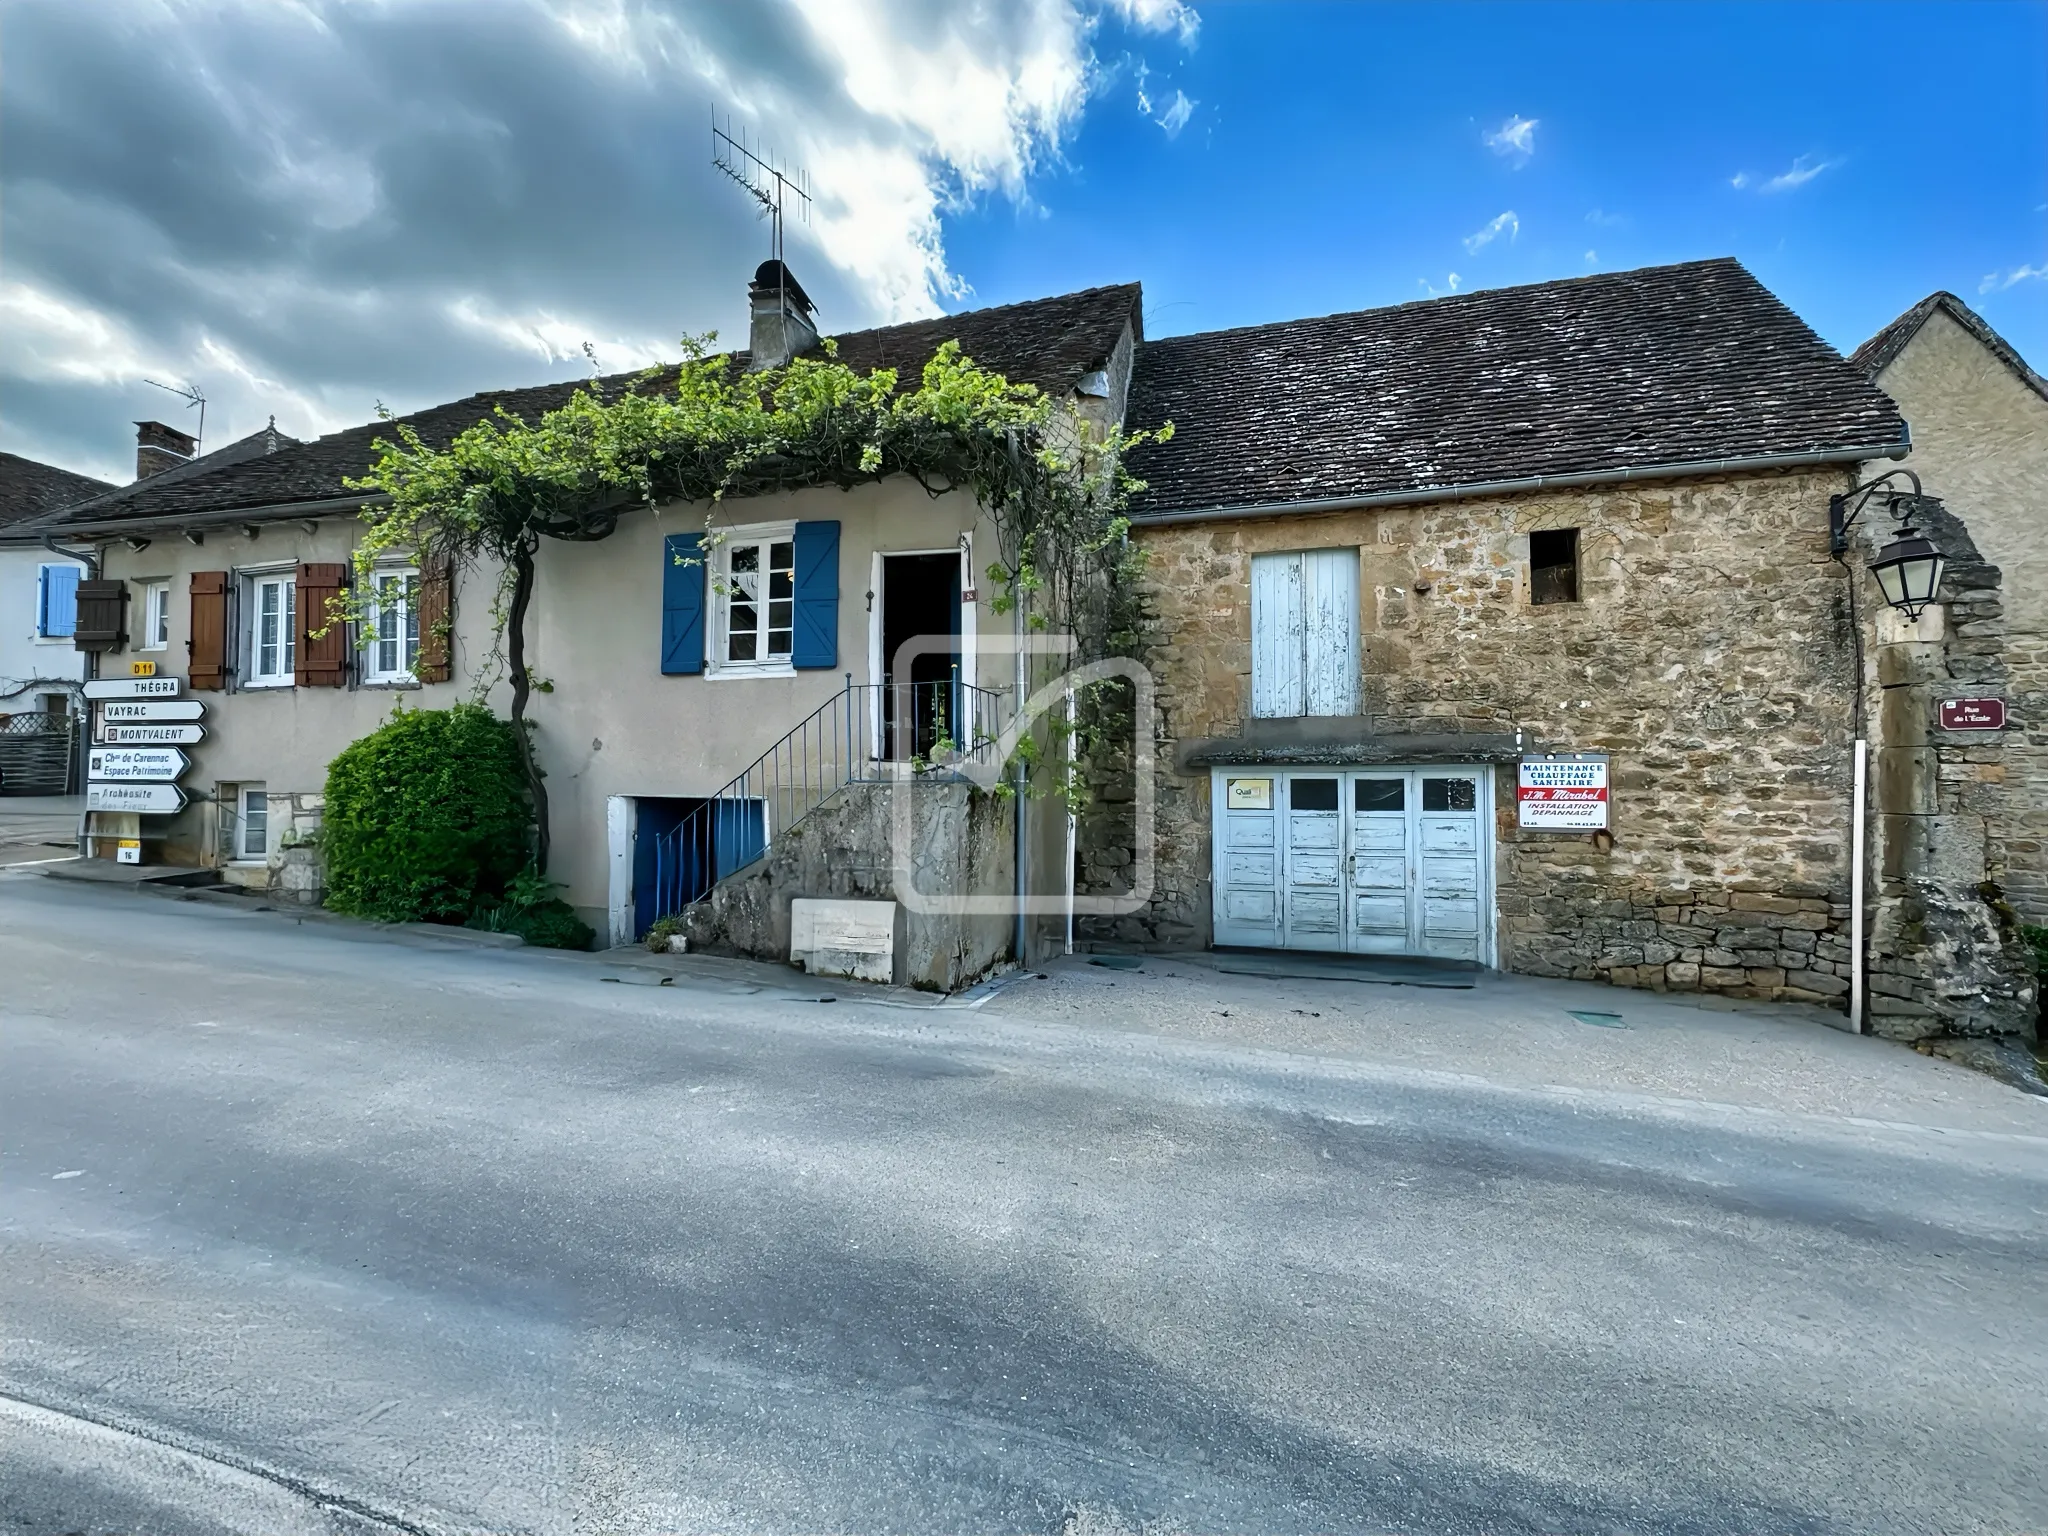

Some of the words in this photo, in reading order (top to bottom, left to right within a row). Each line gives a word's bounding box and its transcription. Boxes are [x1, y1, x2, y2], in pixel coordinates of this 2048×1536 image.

[134, 664, 140, 674] D
[143, 664, 153, 674] 11
[135, 681, 175, 693] THÉGRA
[107, 706, 147, 716] VAYRAC
[120, 729, 184, 739] MONTVALENT
[122, 753, 132, 763] de
[134, 753, 170, 763] Carennac
[104, 766, 130, 777] Espace
[132, 766, 173, 776] Patrimoine
[1523, 791, 1547, 800] J.M.
[1551, 789, 1601, 800] Mirabel
[125, 852, 133, 860] 16
